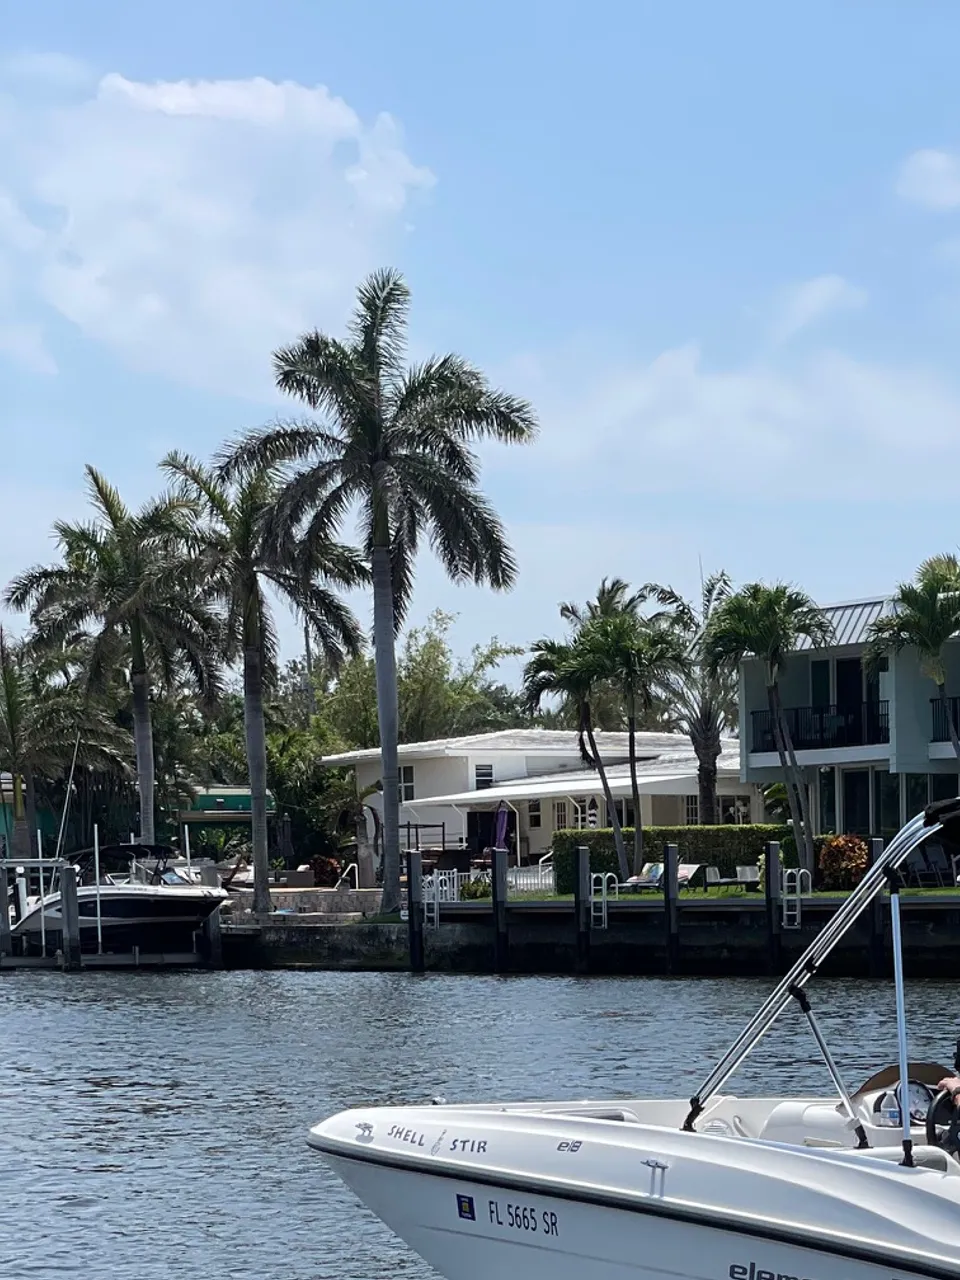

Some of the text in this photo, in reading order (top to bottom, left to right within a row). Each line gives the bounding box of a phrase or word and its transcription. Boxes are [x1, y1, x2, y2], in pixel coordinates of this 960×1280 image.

[387, 1125, 488, 1153] SHELL STIR
[488, 1200, 504, 1226] FL
[507, 1203, 538, 1232] 5665
[542, 1211, 559, 1236] SR
